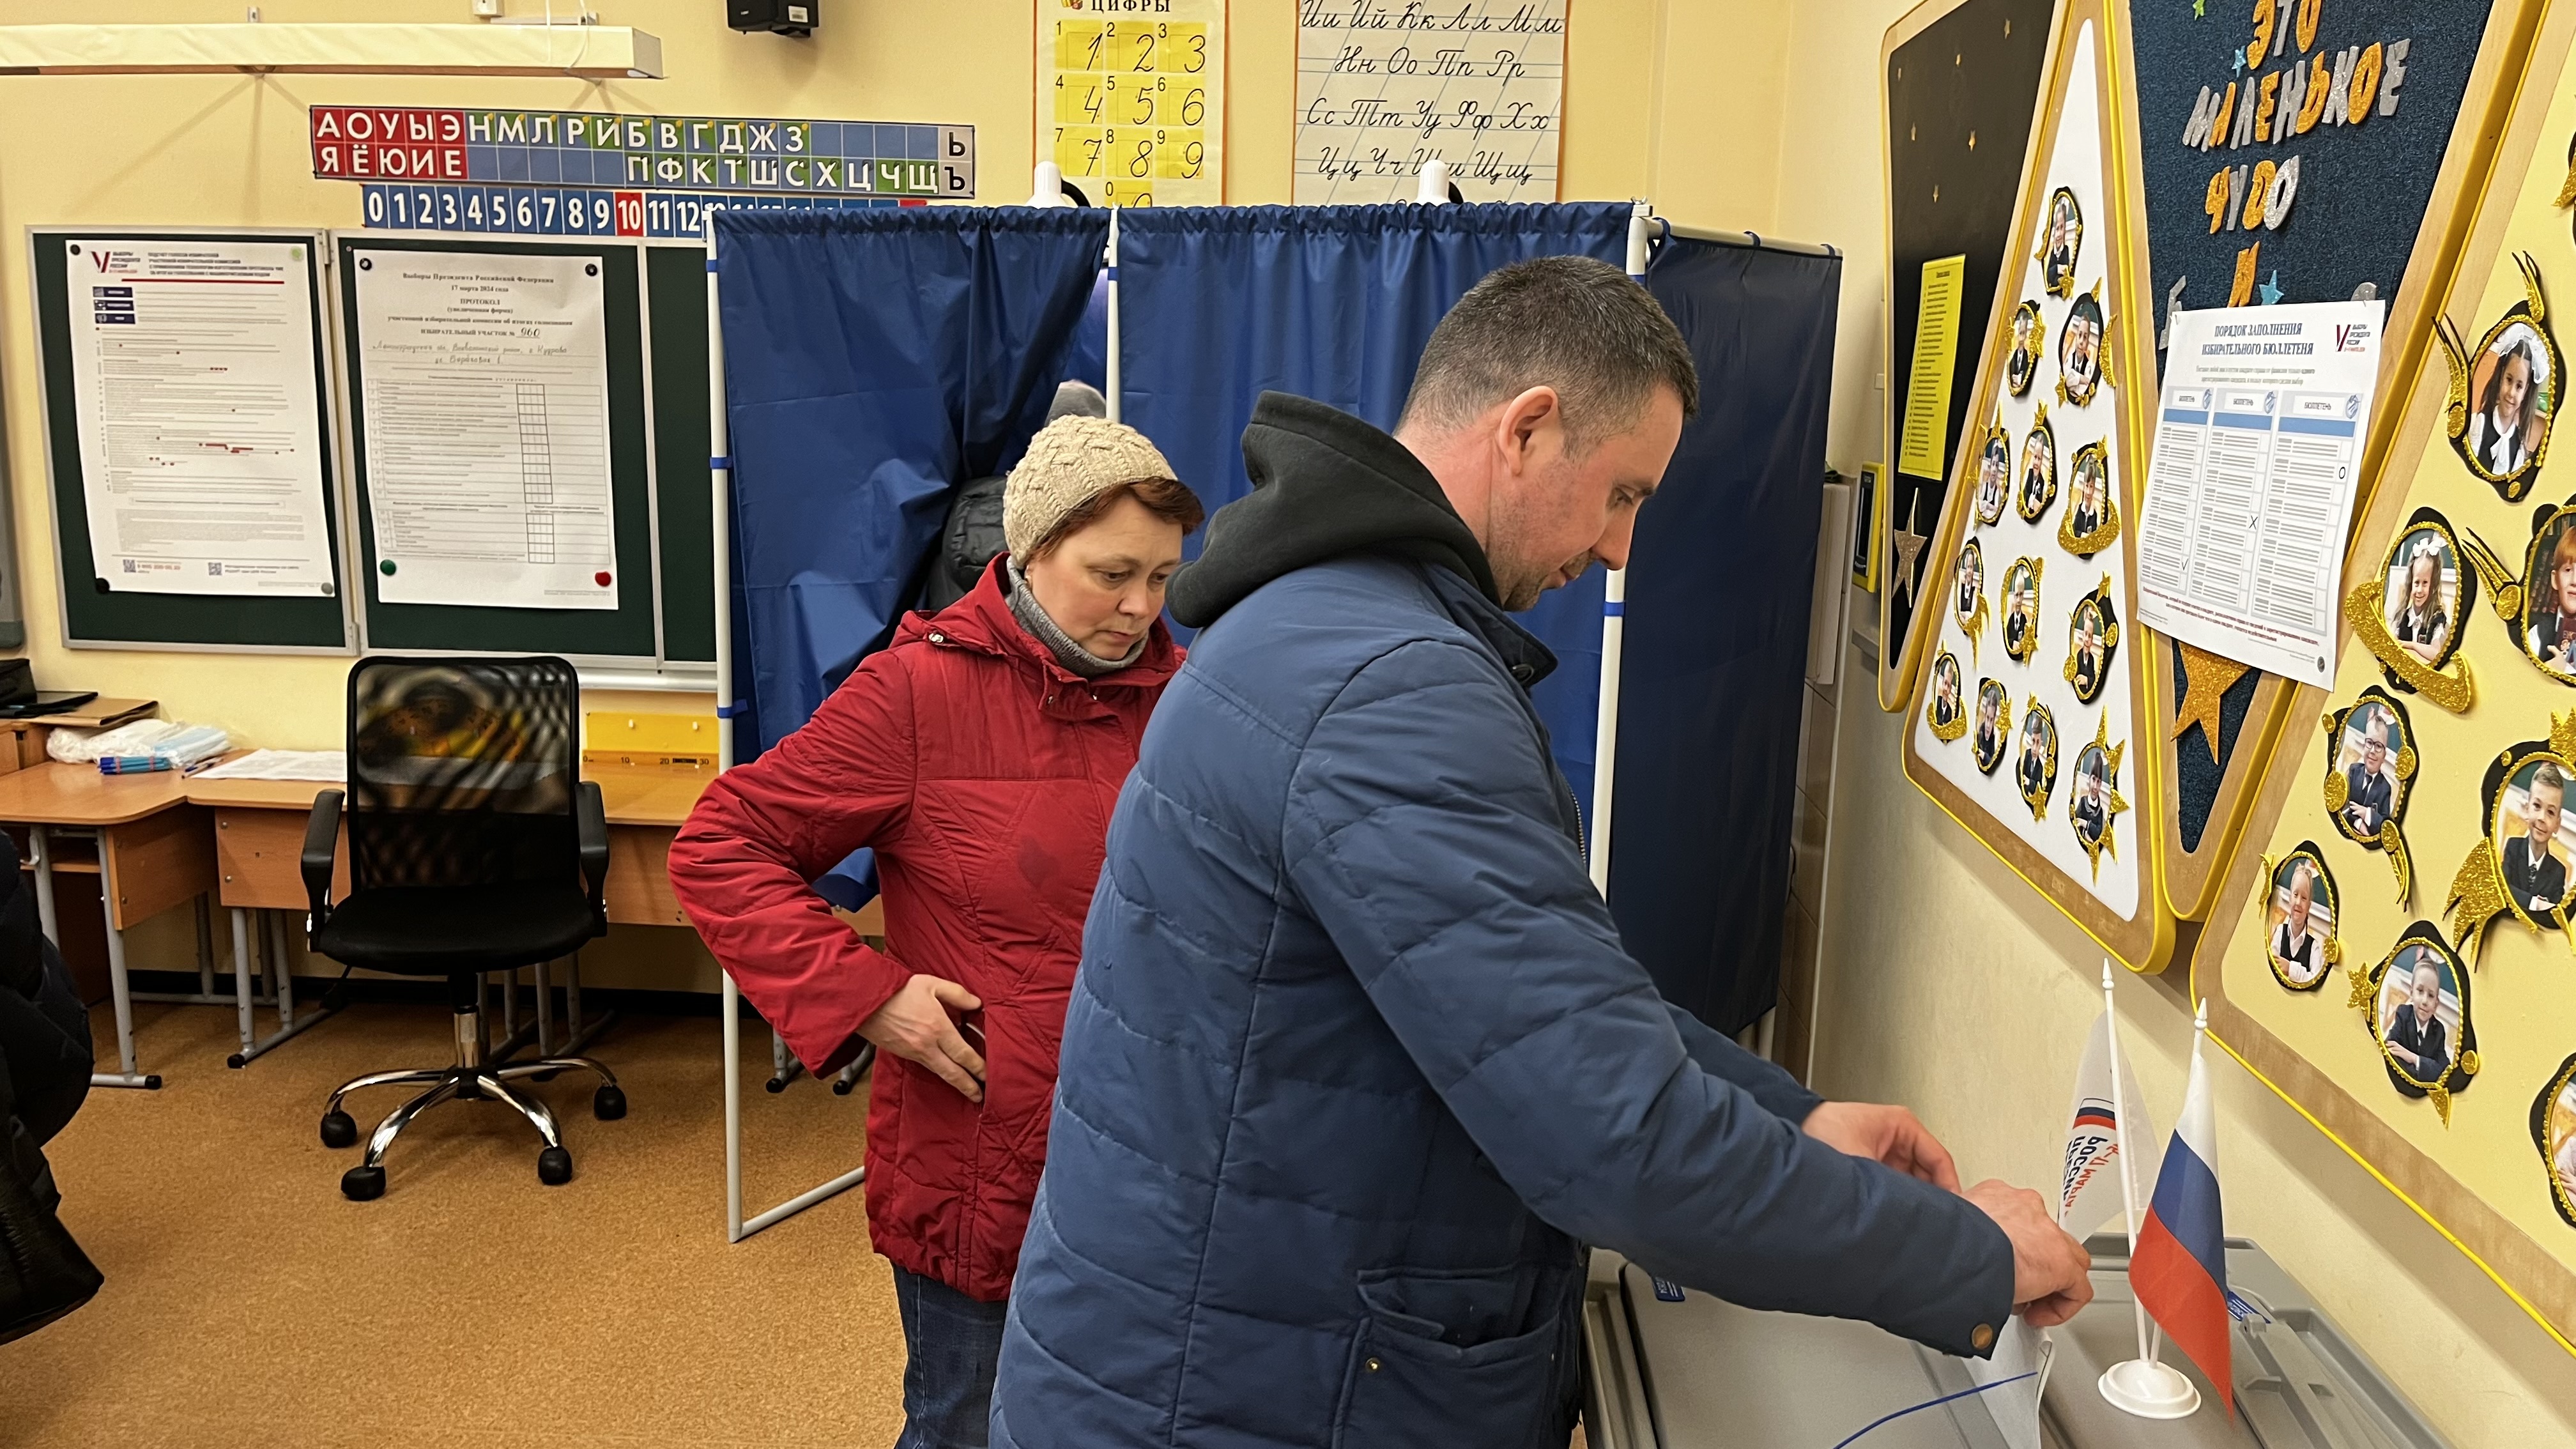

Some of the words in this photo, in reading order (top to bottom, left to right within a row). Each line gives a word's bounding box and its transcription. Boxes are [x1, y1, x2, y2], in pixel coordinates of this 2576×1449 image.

[2247, 0, 2323, 70] ЭТО
[2182, 38, 2411, 152] МАЛЕНЬКОЕ
[618, 199, 641, 230] 10
[648, 200, 670, 231] 11
[677, 201, 700, 232] 12
[521, 327, 540, 338] 960
[2214, 325, 2248, 337] ПОРЯДОК
[2248, 323, 2303, 336] ЗАПОЛНЕНИЯ
[2202, 343, 2261, 355] ИЗБИРАТЕЛЬНОГО
[2262, 342, 2313, 355] БЮЛЛЕТЕНЯ
